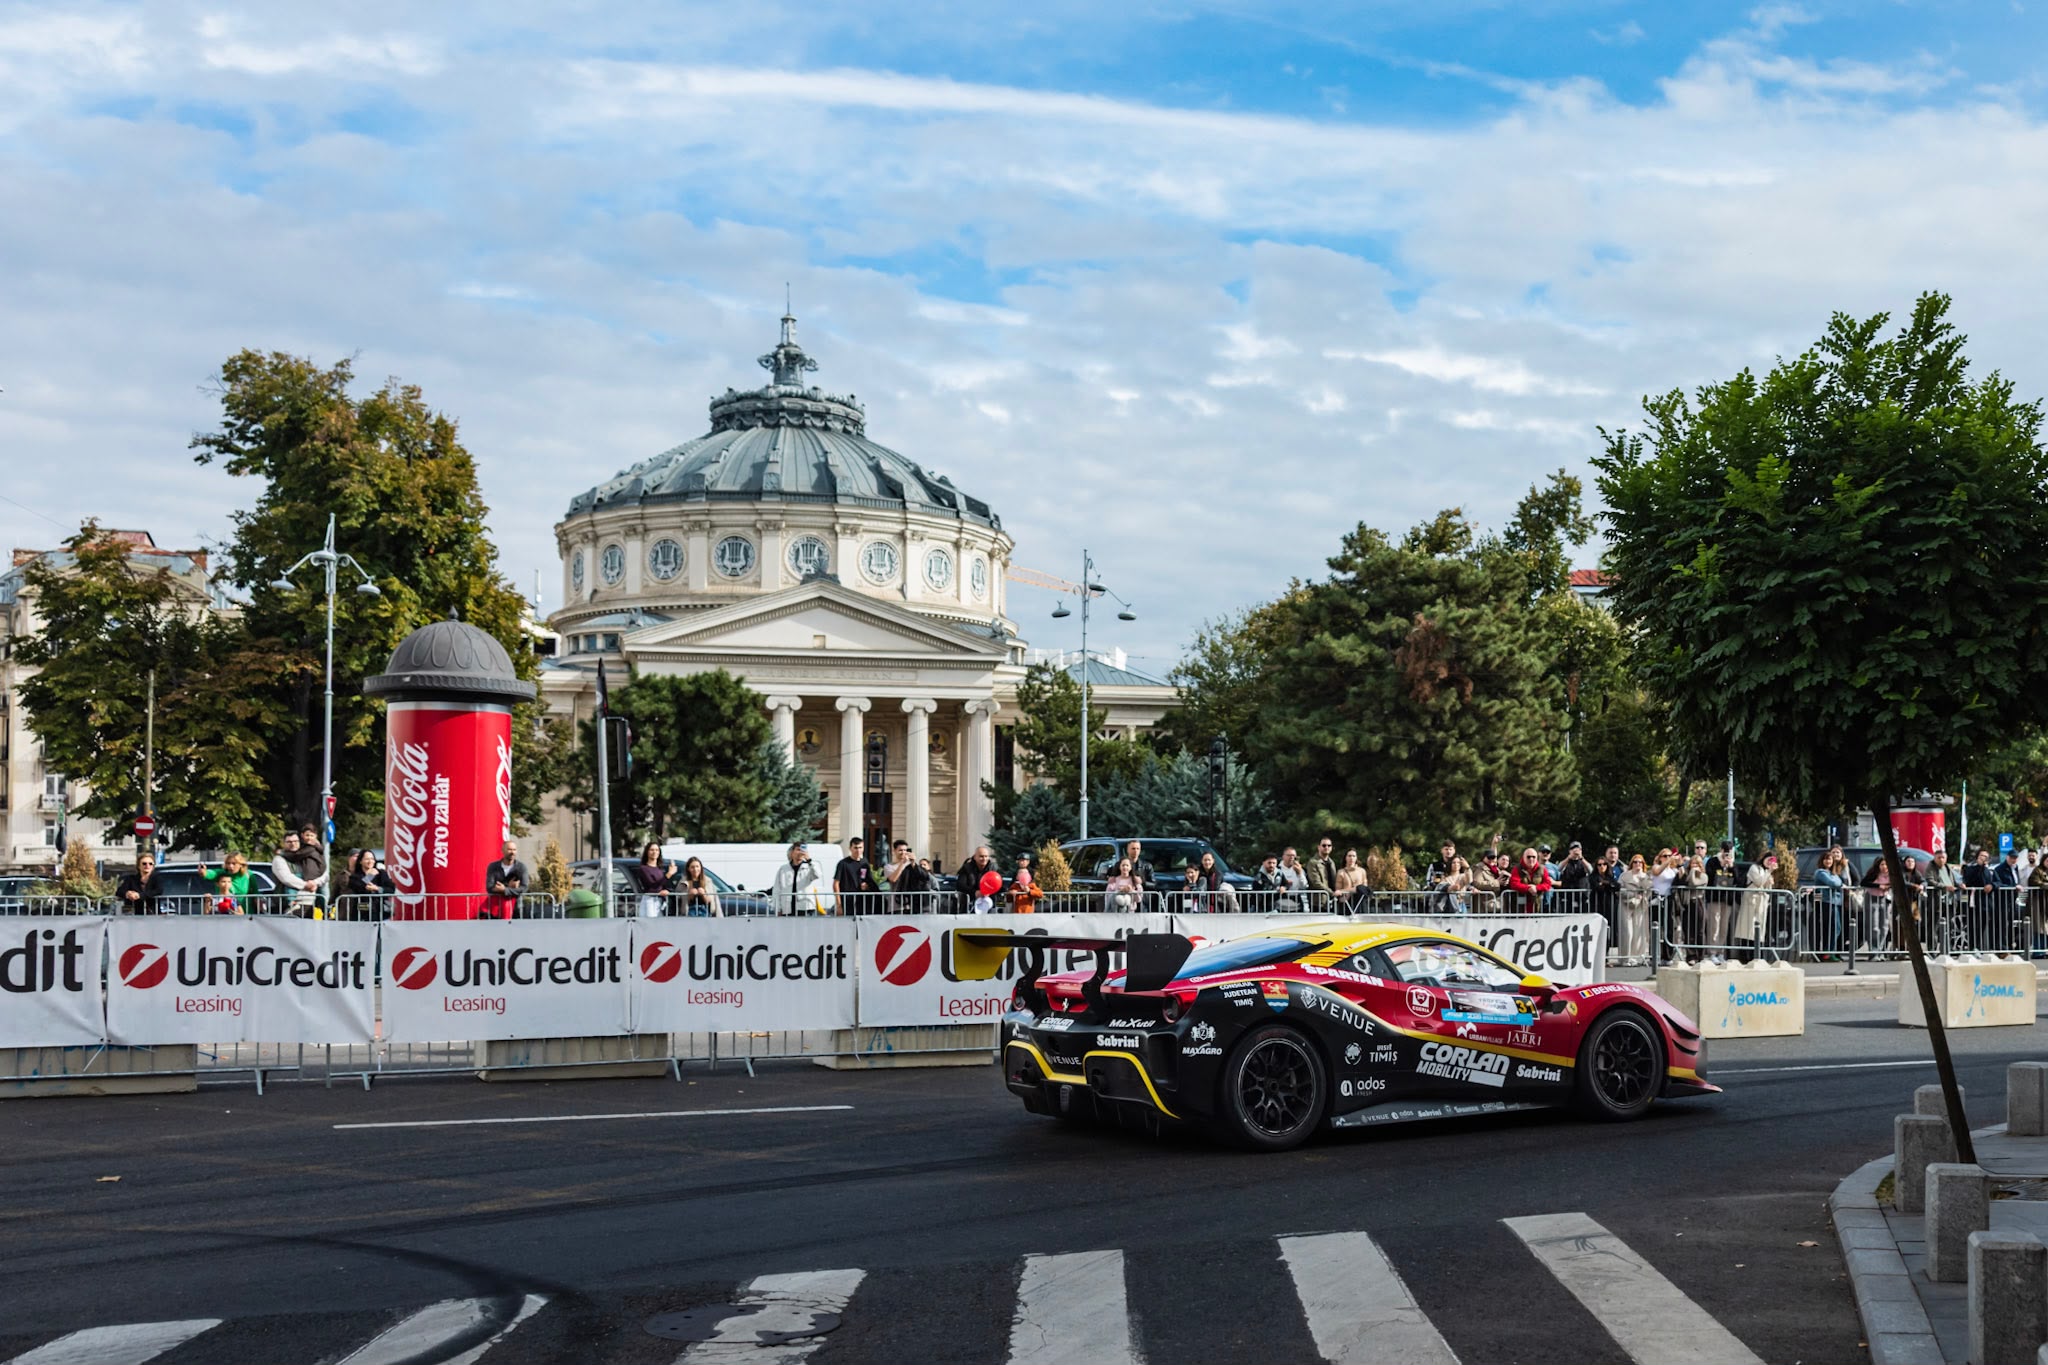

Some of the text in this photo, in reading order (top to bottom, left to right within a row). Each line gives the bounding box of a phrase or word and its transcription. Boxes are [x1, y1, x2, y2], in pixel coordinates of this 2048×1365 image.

[433, 825, 449, 868] zero
[2001, 836, 2010, 847] P
[177, 946, 365, 991] UniCredit
[444, 946, 621, 987] UniCredit
[688, 944, 847, 981] UniCredit
[1301, 963, 1384, 987] SPARTAN
[175, 995, 243, 1016] Leasing
[444, 995, 506, 1015] Leasing
[687, 989, 743, 1008] Leasing
[1516, 1000, 1536, 1013] 31
[1319, 997, 1376, 1036] VENUE
[1096, 1034, 1140, 1048] Sabrini
[1507, 1031, 1541, 1046] JABRI
[1182, 1045, 1222, 1056] MAXAGRO
[1420, 1042, 1510, 1074] CORLAN
[1416, 1060, 1471, 1081] MOBILITY
[1516, 1064, 1561, 1082] Sabrini
[1357, 1076, 1386, 1090] ados
